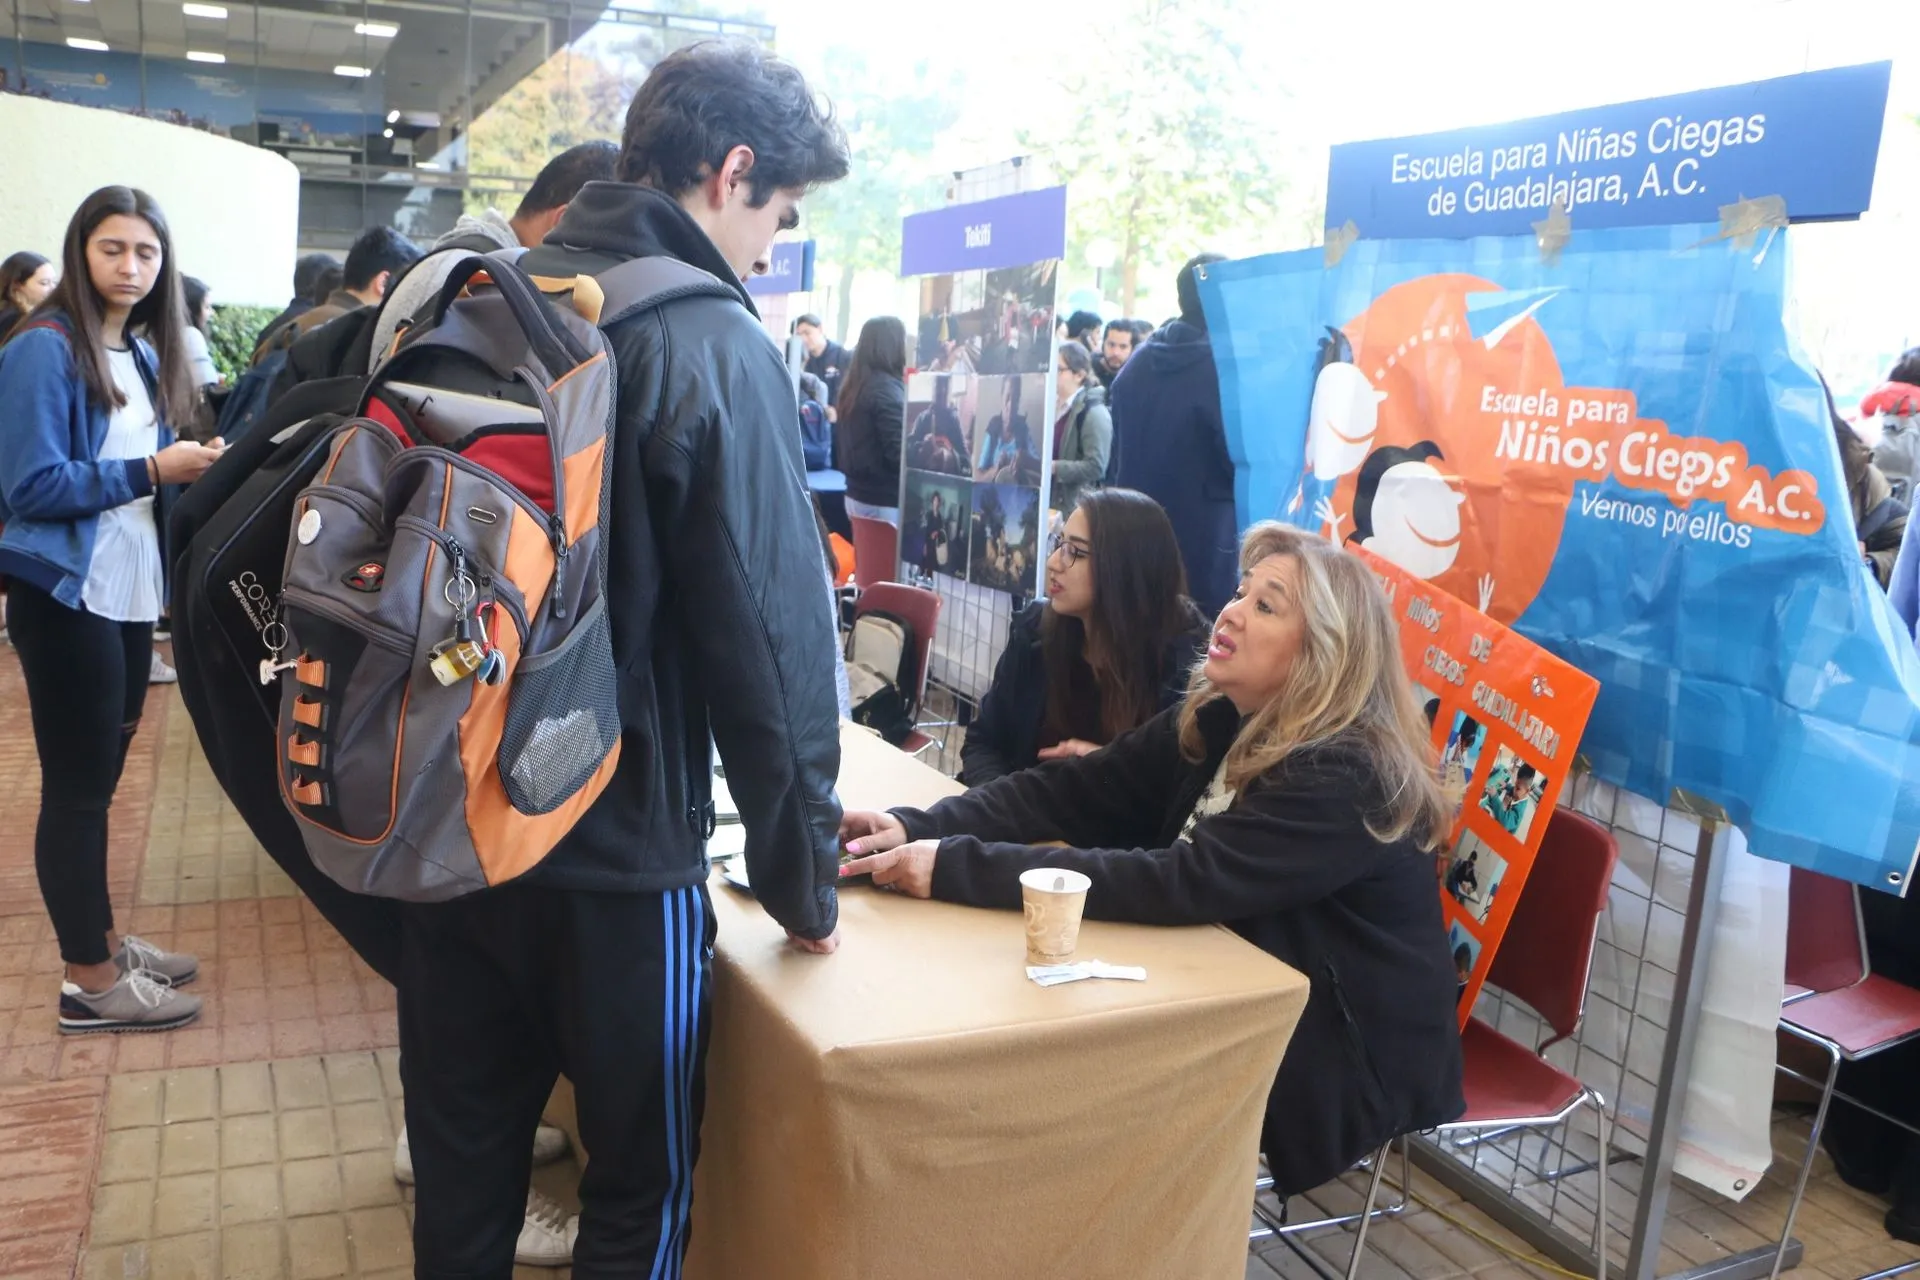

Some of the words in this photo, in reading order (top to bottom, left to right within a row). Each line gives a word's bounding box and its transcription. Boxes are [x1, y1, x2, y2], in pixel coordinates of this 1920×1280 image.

[1391, 146, 1483, 183] Escuela
[1491, 142, 1547, 178] para
[1556, 127, 1637, 166] Niñas
[1648, 114, 1766, 157] Ciegas
[1428, 188, 1456, 216] de
[1464, 171, 1629, 213] Guadalajara,
[1637, 158, 1706, 199] A.C.
[1480, 385, 1558, 418] Escuela
[1566, 397, 1630, 427] para
[1495, 419, 1609, 471] Niños
[1737, 479, 1812, 521] A.C.
[1580, 489, 1657, 529] Vemos
[1689, 511, 1753, 549] ellos
[1469, 633, 1493, 664] DE
